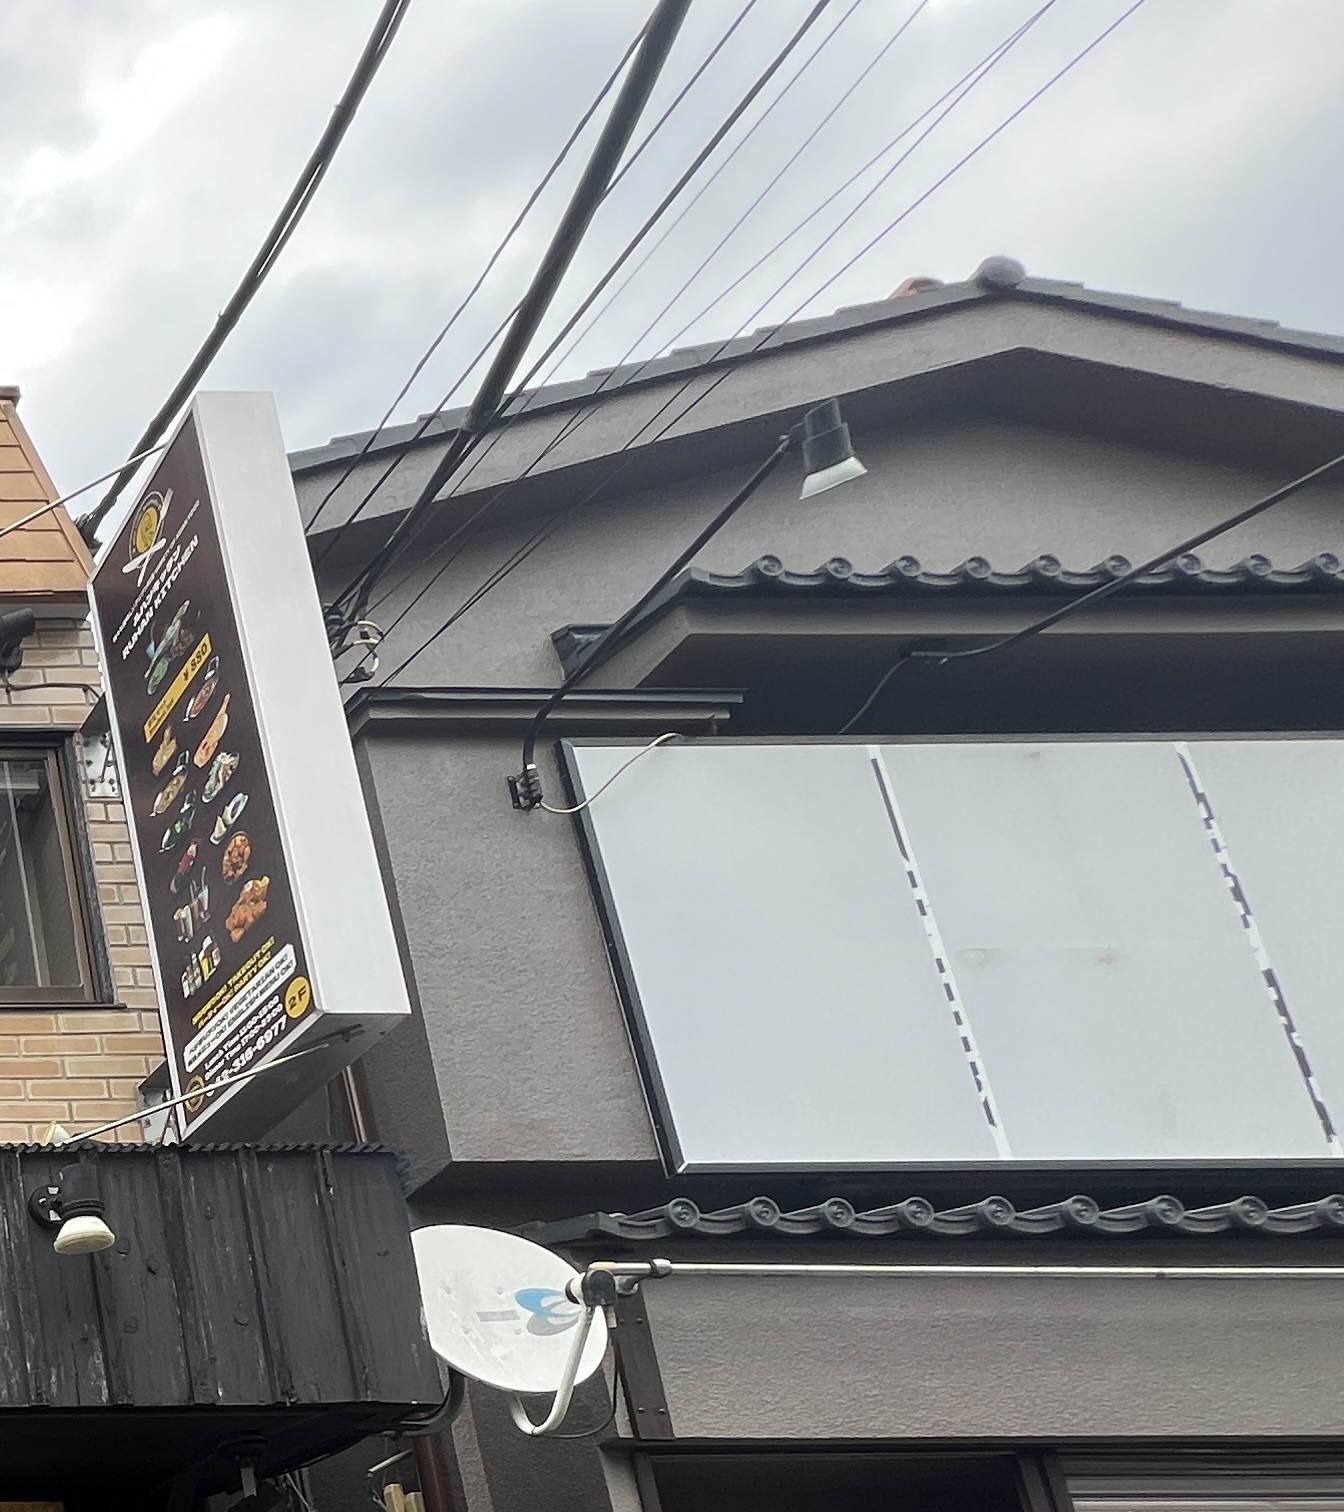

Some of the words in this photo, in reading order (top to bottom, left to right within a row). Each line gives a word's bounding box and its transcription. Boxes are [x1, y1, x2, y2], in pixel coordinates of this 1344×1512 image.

[122, 607, 153, 660] RUHAN
[155, 534, 199, 609] KITCHEN
[288, 985, 306, 1011] 2F
